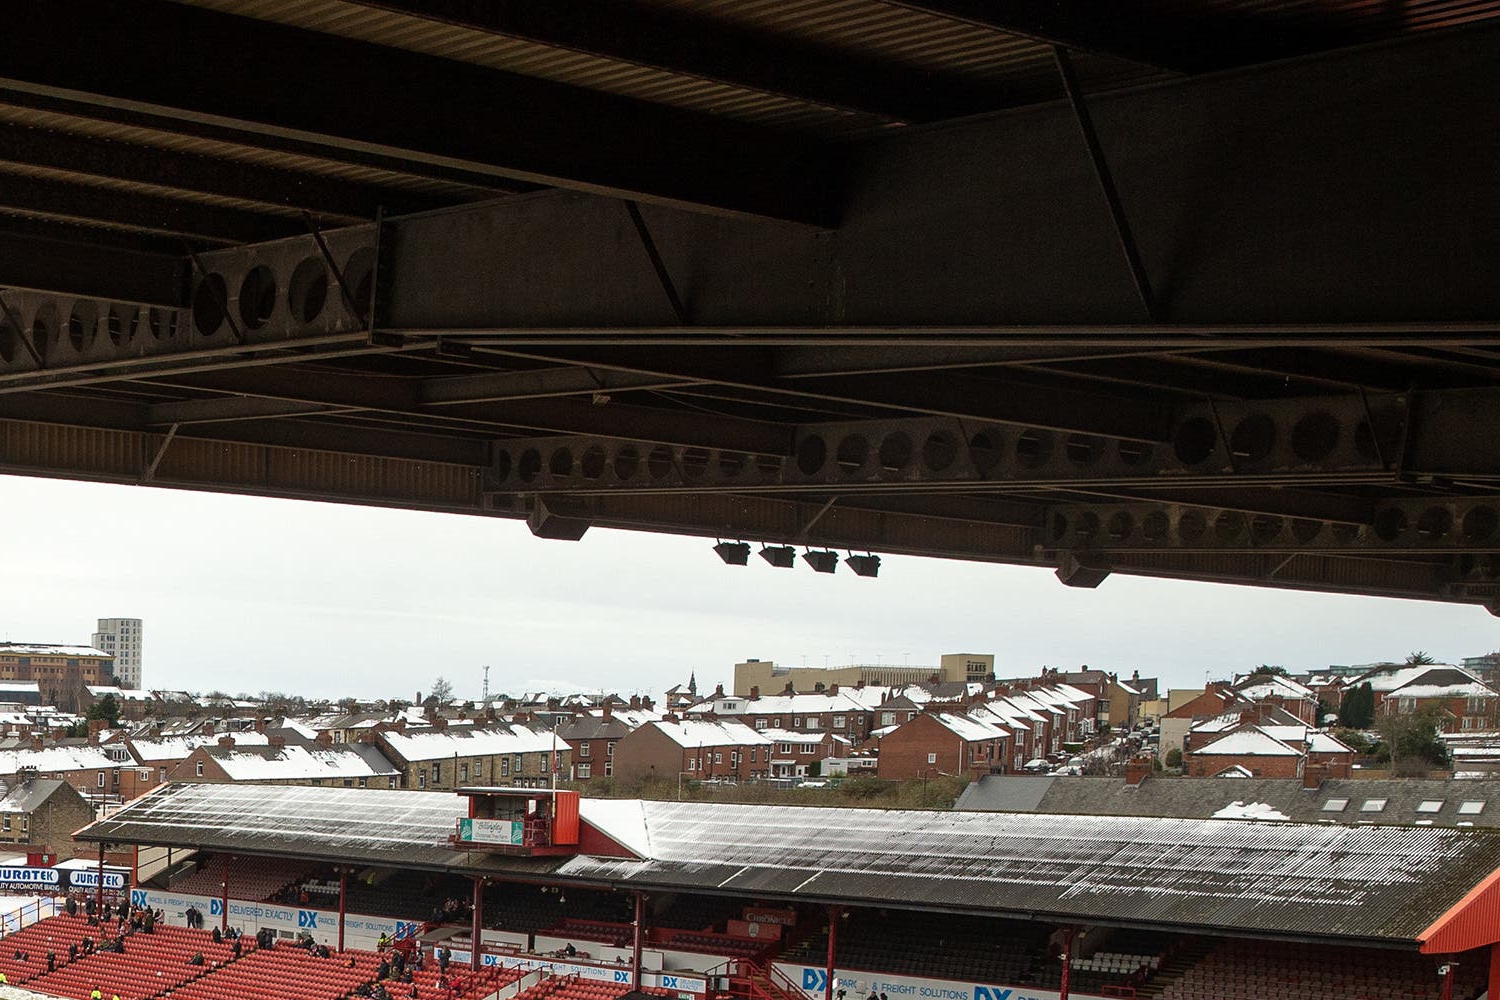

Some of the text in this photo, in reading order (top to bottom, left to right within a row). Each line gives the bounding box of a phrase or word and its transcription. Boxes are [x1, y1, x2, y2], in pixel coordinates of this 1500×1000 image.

[9, 882, 43, 890] AUTOMOTIVE
[132, 890, 148, 907] DX
[229, 904, 263, 917] DELIVERED
[266, 908, 294, 921] EXACTLY
[298, 910, 318, 929] DX
[346, 920, 364, 928] REIGHT
[365, 922, 393, 932] SOLUTIONS
[485, 955, 498, 965] DX
[571, 966, 607, 976] SOLUTIONS
[614, 971, 629, 983] DX
[663, 976, 678, 988] DX
[839, 978, 867, 990] PARC
[872, 982, 878, 991] &
[882, 983, 916, 995] FREIGHT
[920, 987, 968, 1000] SOLUTIONS
